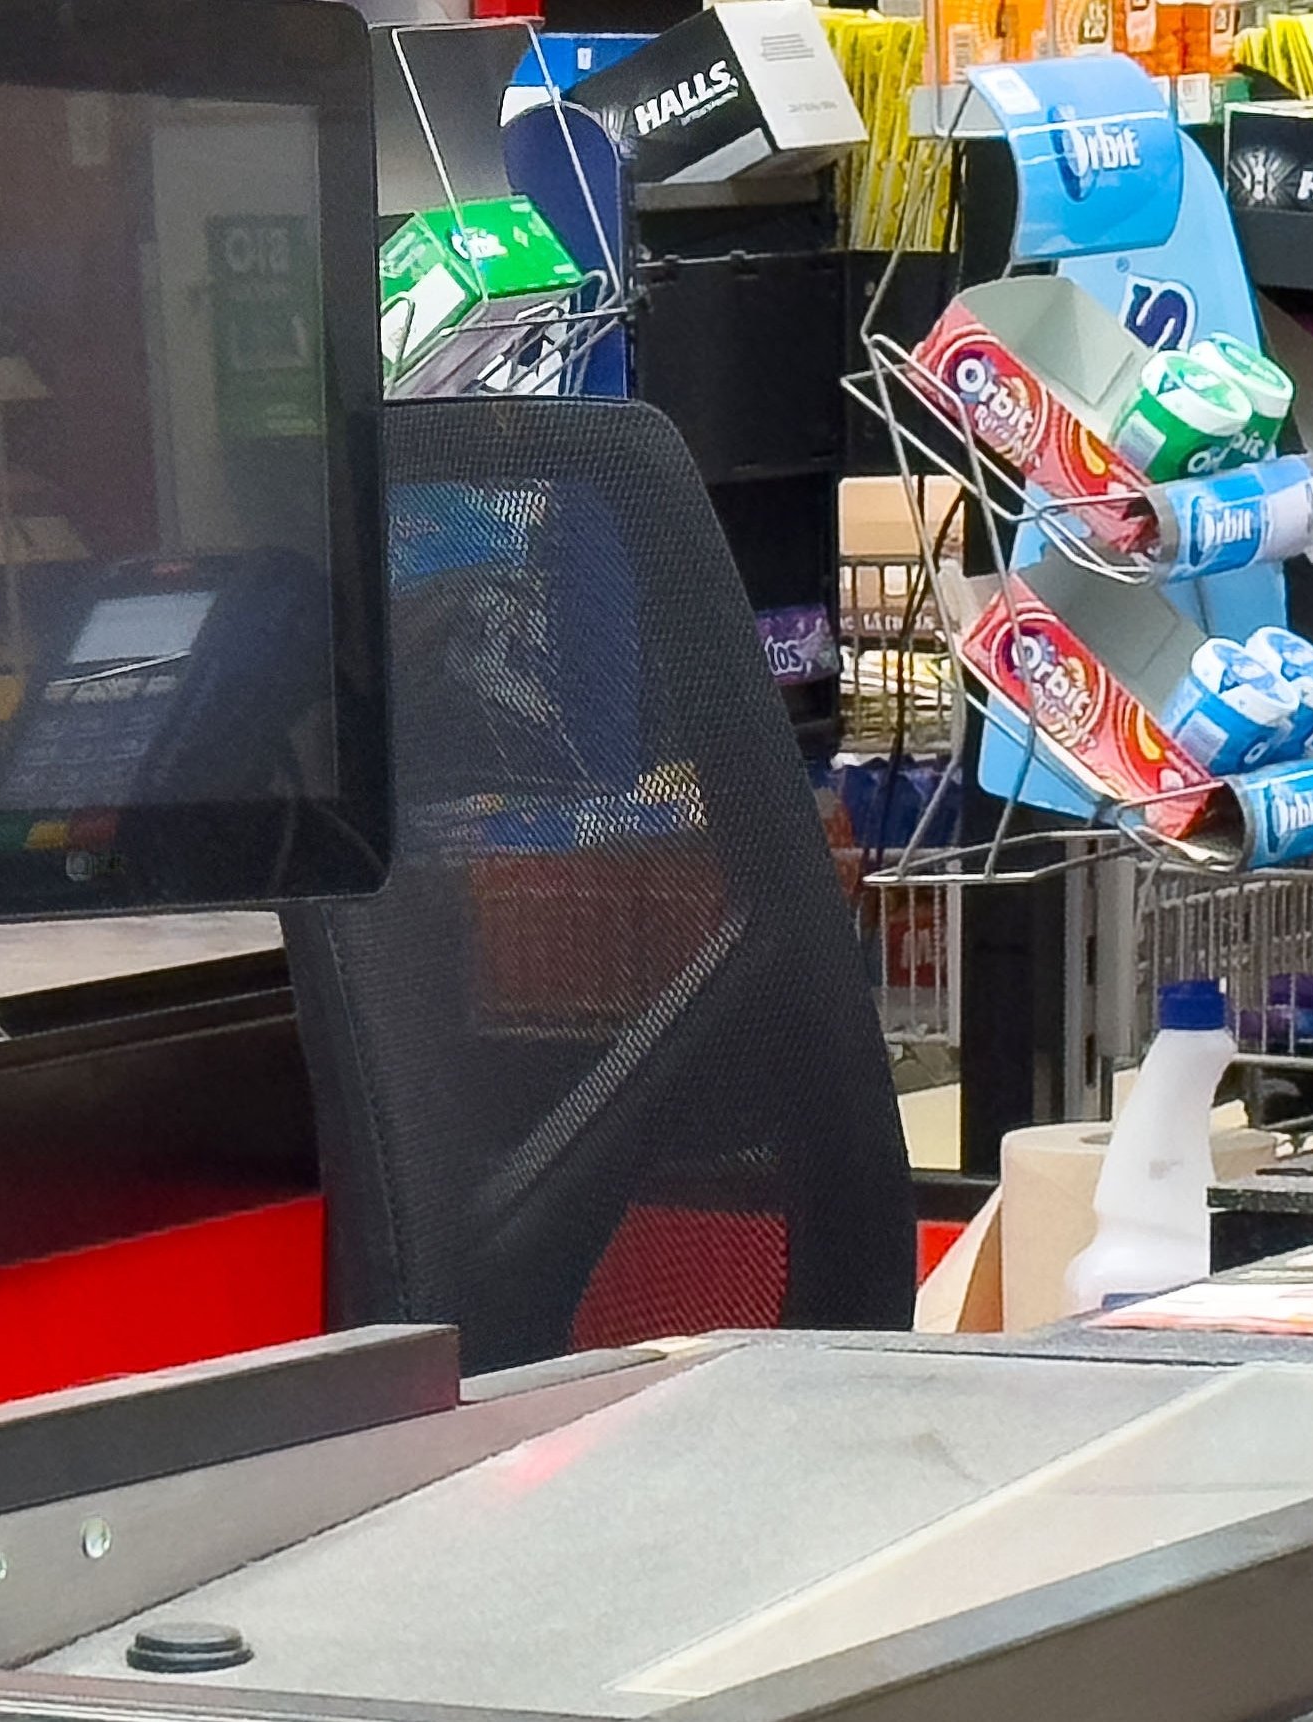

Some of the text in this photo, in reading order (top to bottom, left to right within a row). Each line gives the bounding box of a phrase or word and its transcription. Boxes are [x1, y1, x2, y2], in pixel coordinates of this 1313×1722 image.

[1055, 118, 1141, 182] Orbit
[955, 357, 1034, 437] Orbit
[1193, 497, 1252, 556] Orbit
[1011, 634, 1091, 718] Orbit
